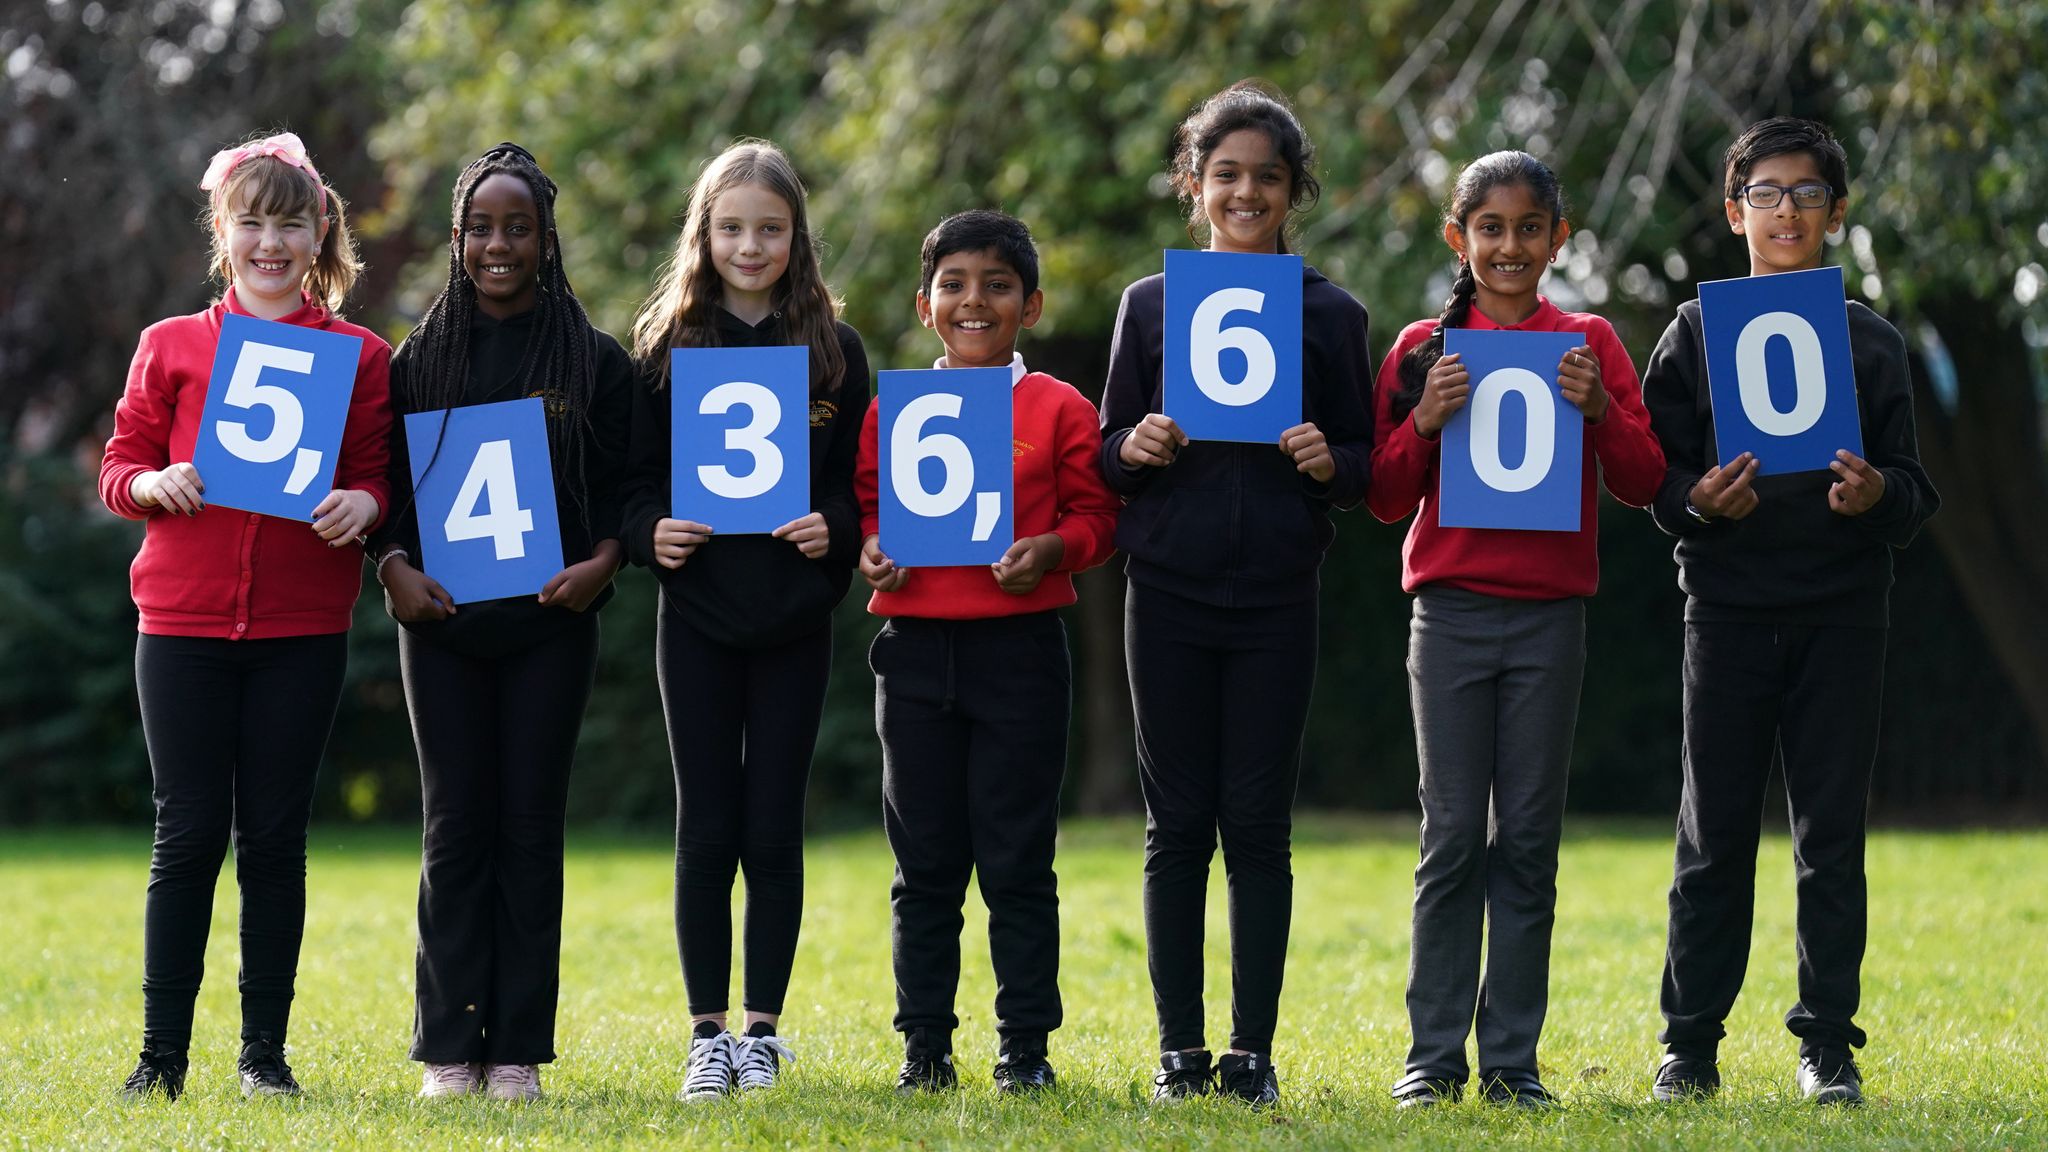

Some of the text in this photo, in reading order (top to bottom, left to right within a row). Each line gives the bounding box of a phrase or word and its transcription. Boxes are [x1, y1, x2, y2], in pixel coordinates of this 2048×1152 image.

[1190, 287, 1276, 407] 6
[1735, 311, 1827, 436] 0
[215, 340, 323, 496] 5,
[697, 381, 784, 499] 3
[890, 392, 1001, 542] 6,
[1469, 367, 1556, 493] 0
[443, 439, 534, 561] 4
